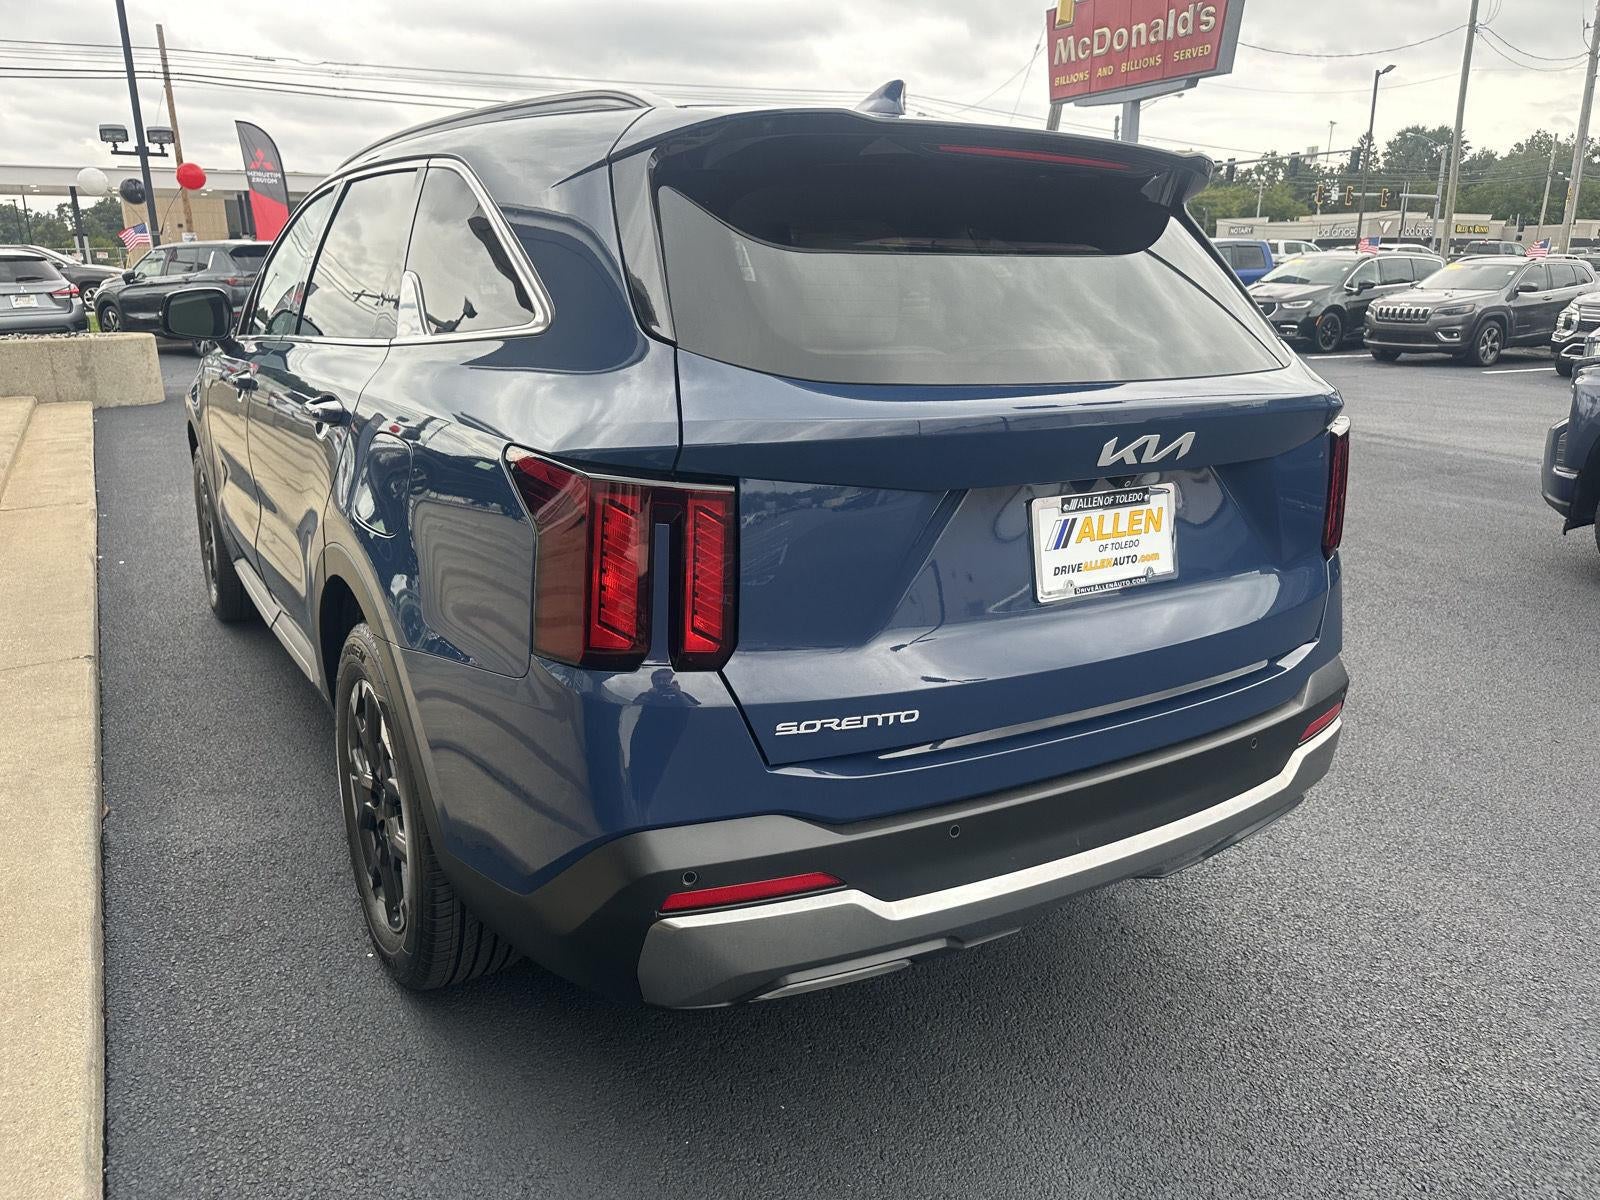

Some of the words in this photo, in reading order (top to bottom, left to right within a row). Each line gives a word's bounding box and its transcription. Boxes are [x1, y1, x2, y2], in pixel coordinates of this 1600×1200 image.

[1054, 2, 1217, 65] McDonald's
[1054, 70, 1089, 86] BILLIONS
[1097, 65, 1114, 78] AND
[1120, 54, 1162, 73] BILLIONS
[1173, 44, 1211, 62] SERVED
[1229, 226, 1252, 235] NOTARY
[1097, 432, 1196, 467] KIA
[1077, 497, 1104, 509] ALLEN
[1104, 496, 1113, 505] OF
[1115, 492, 1143, 505] TOLEDO
[1075, 507, 1164, 544] ALLEN
[1098, 544, 1109, 553] OF
[1110, 539, 1140, 551] TOLEDO
[775, 709, 920, 736] SORENTO
